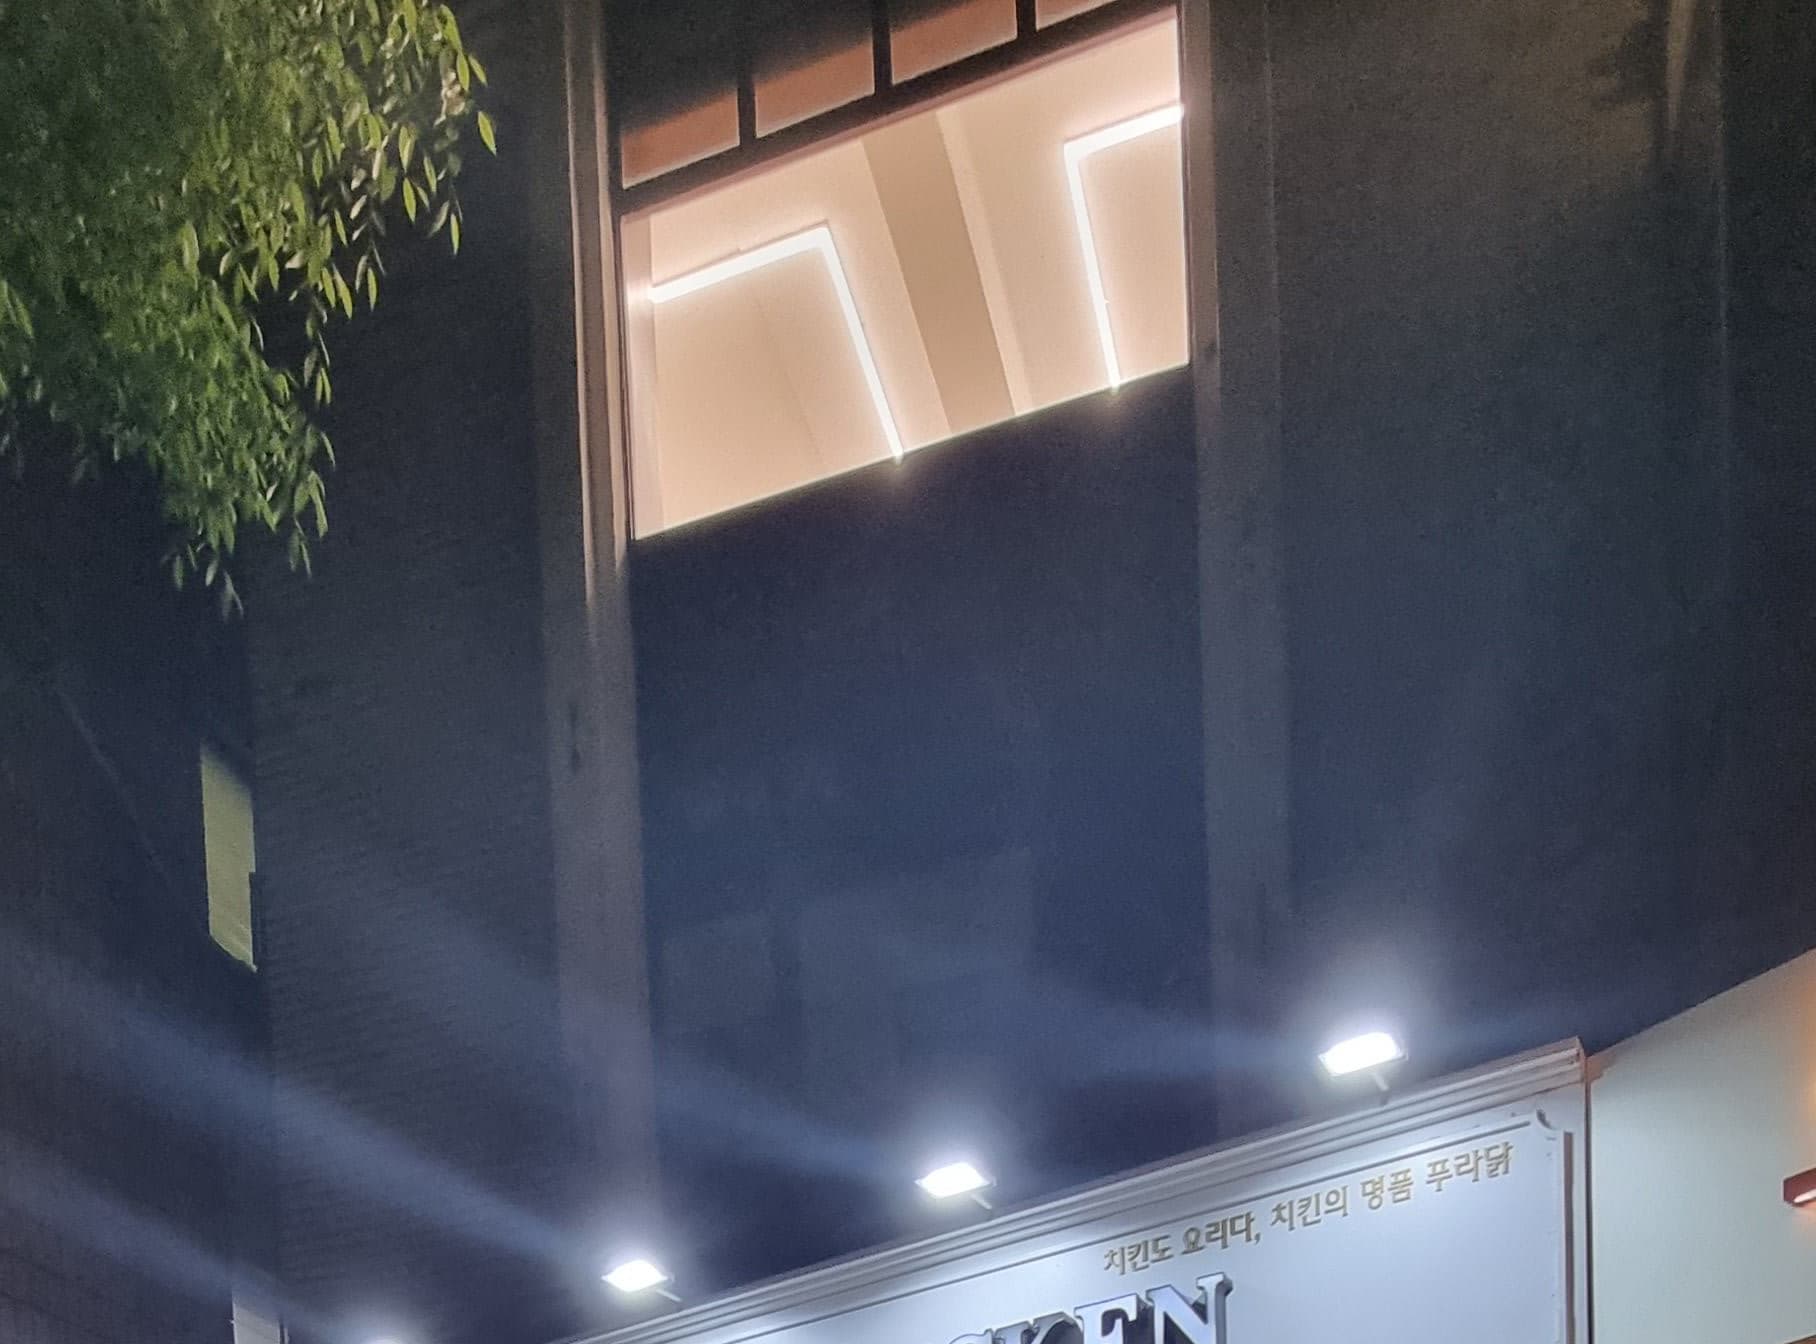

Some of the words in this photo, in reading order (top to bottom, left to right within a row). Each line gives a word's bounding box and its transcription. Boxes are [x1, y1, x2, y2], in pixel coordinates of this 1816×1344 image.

[1103, 1233, 1175, 1276] 치킨도
[1180, 1211, 1262, 1256] 요리다,
[1269, 1184, 1349, 1232] 치킨의
[1359, 1167, 1415, 1212] 명품
[1424, 1140, 1514, 1193] 푸라닭
